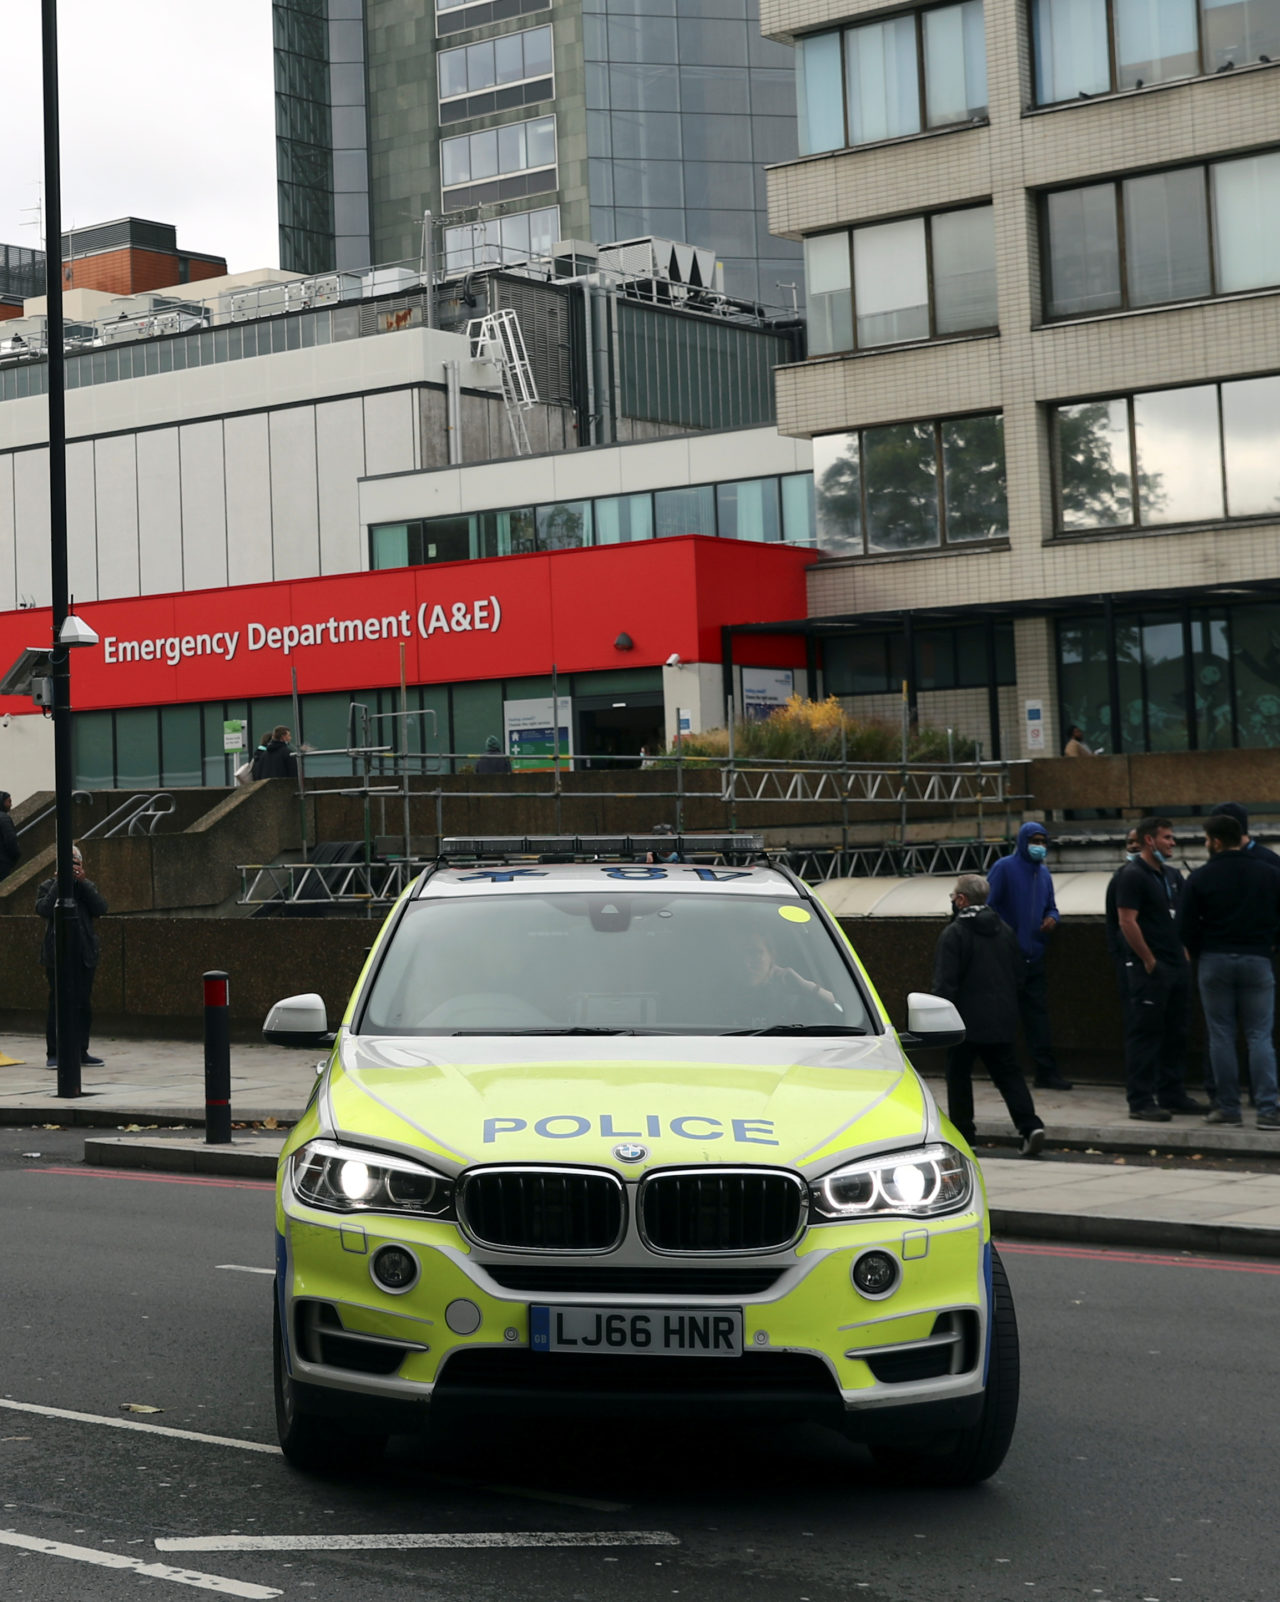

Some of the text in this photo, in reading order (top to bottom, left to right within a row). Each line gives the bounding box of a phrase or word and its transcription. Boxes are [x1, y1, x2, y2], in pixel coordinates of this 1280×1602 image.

[104, 595, 501, 666] Emergency Department (A&E)
[483, 1114, 779, 1146] POLICE
[534, 1335, 547, 1344] GB
[556, 1312, 735, 1350] LJ66 HNR
